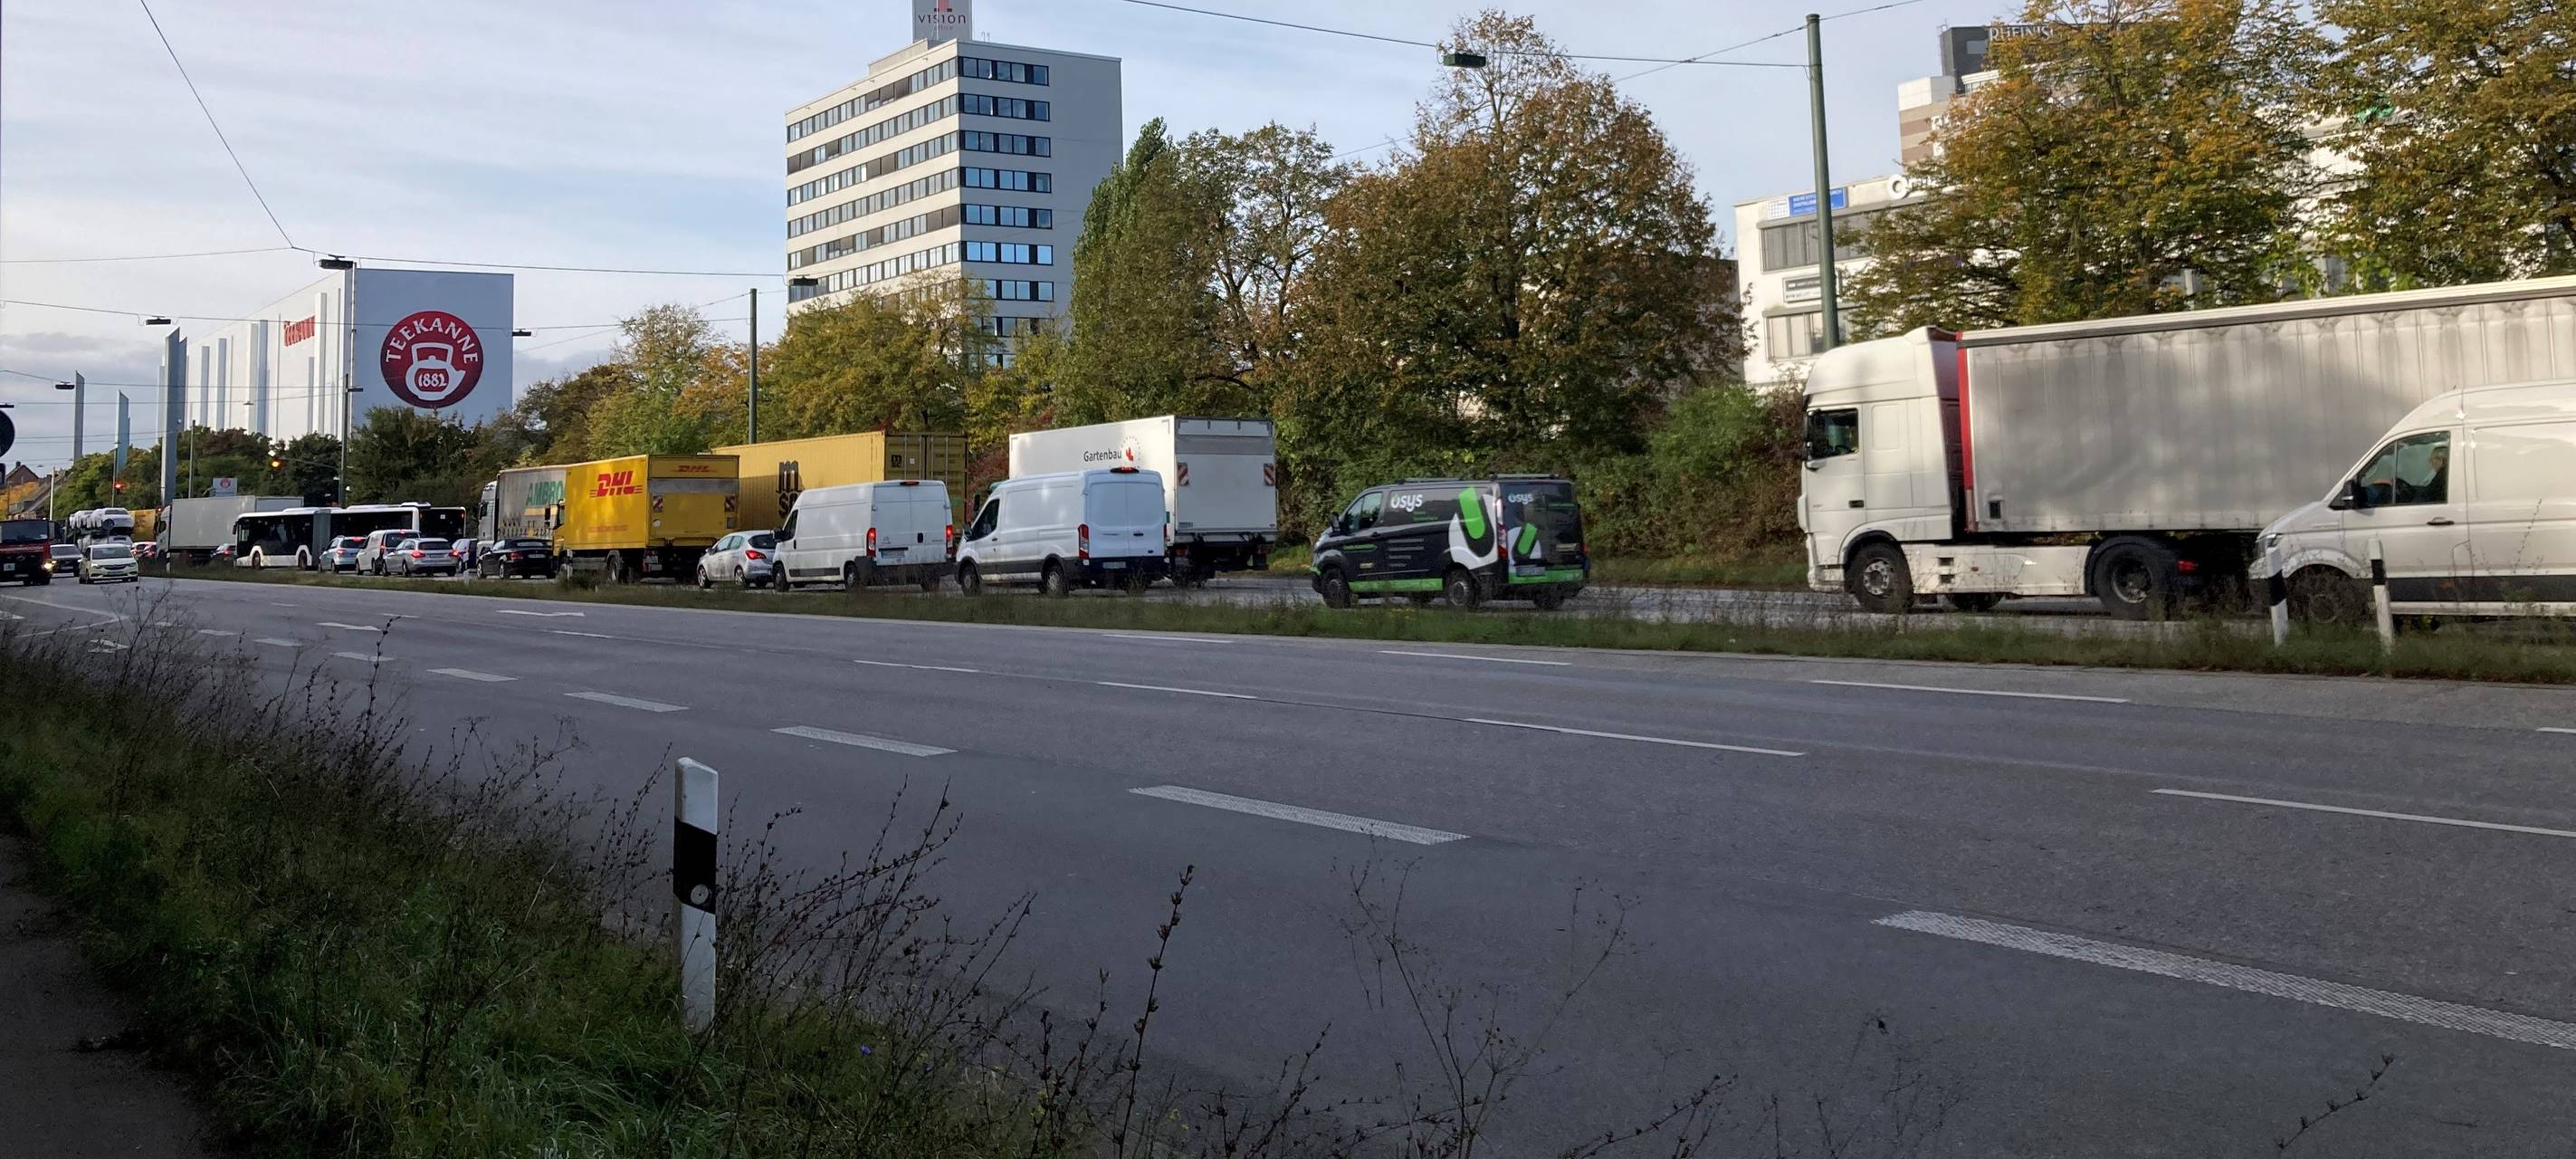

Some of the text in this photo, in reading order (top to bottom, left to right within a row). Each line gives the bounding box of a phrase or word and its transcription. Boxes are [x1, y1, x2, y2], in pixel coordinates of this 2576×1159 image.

[918, 14, 967, 24] vision
[386, 317, 479, 364] TEEKANNE
[418, 373, 447, 388] 1882
[1083, 448, 1122, 463] Gartenbau
[596, 471, 635, 497] DHL
